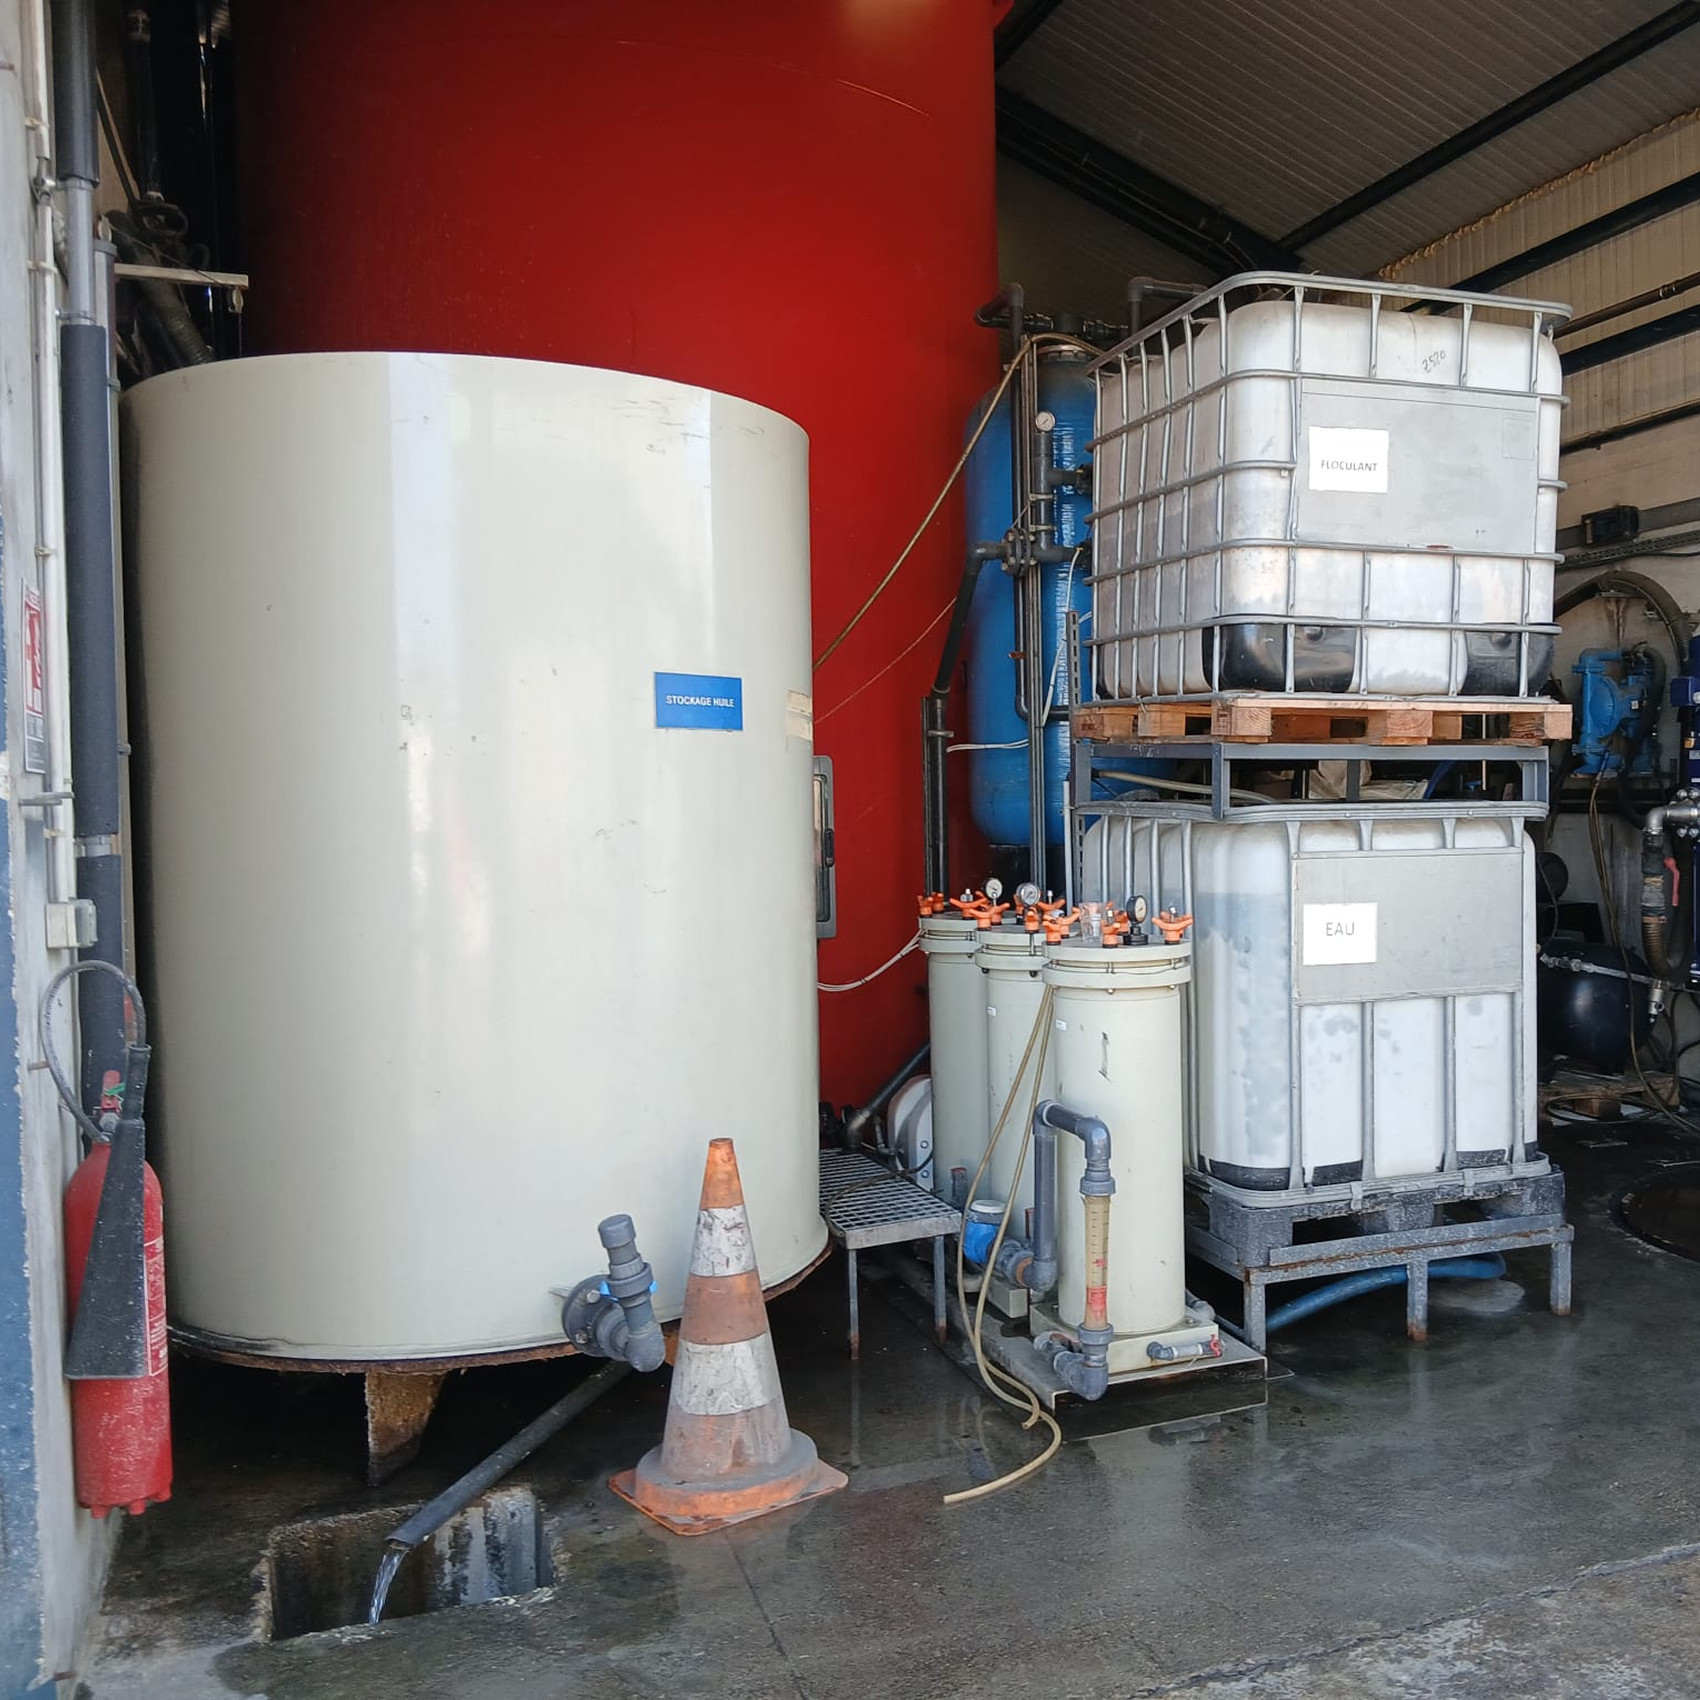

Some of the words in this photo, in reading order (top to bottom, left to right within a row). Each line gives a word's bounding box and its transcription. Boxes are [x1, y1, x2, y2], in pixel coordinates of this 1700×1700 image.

[1321, 459, 1378, 472] FLOCULANT
[665, 694, 712, 706] STOCKAGE
[1326, 921, 1355, 937] EAU
